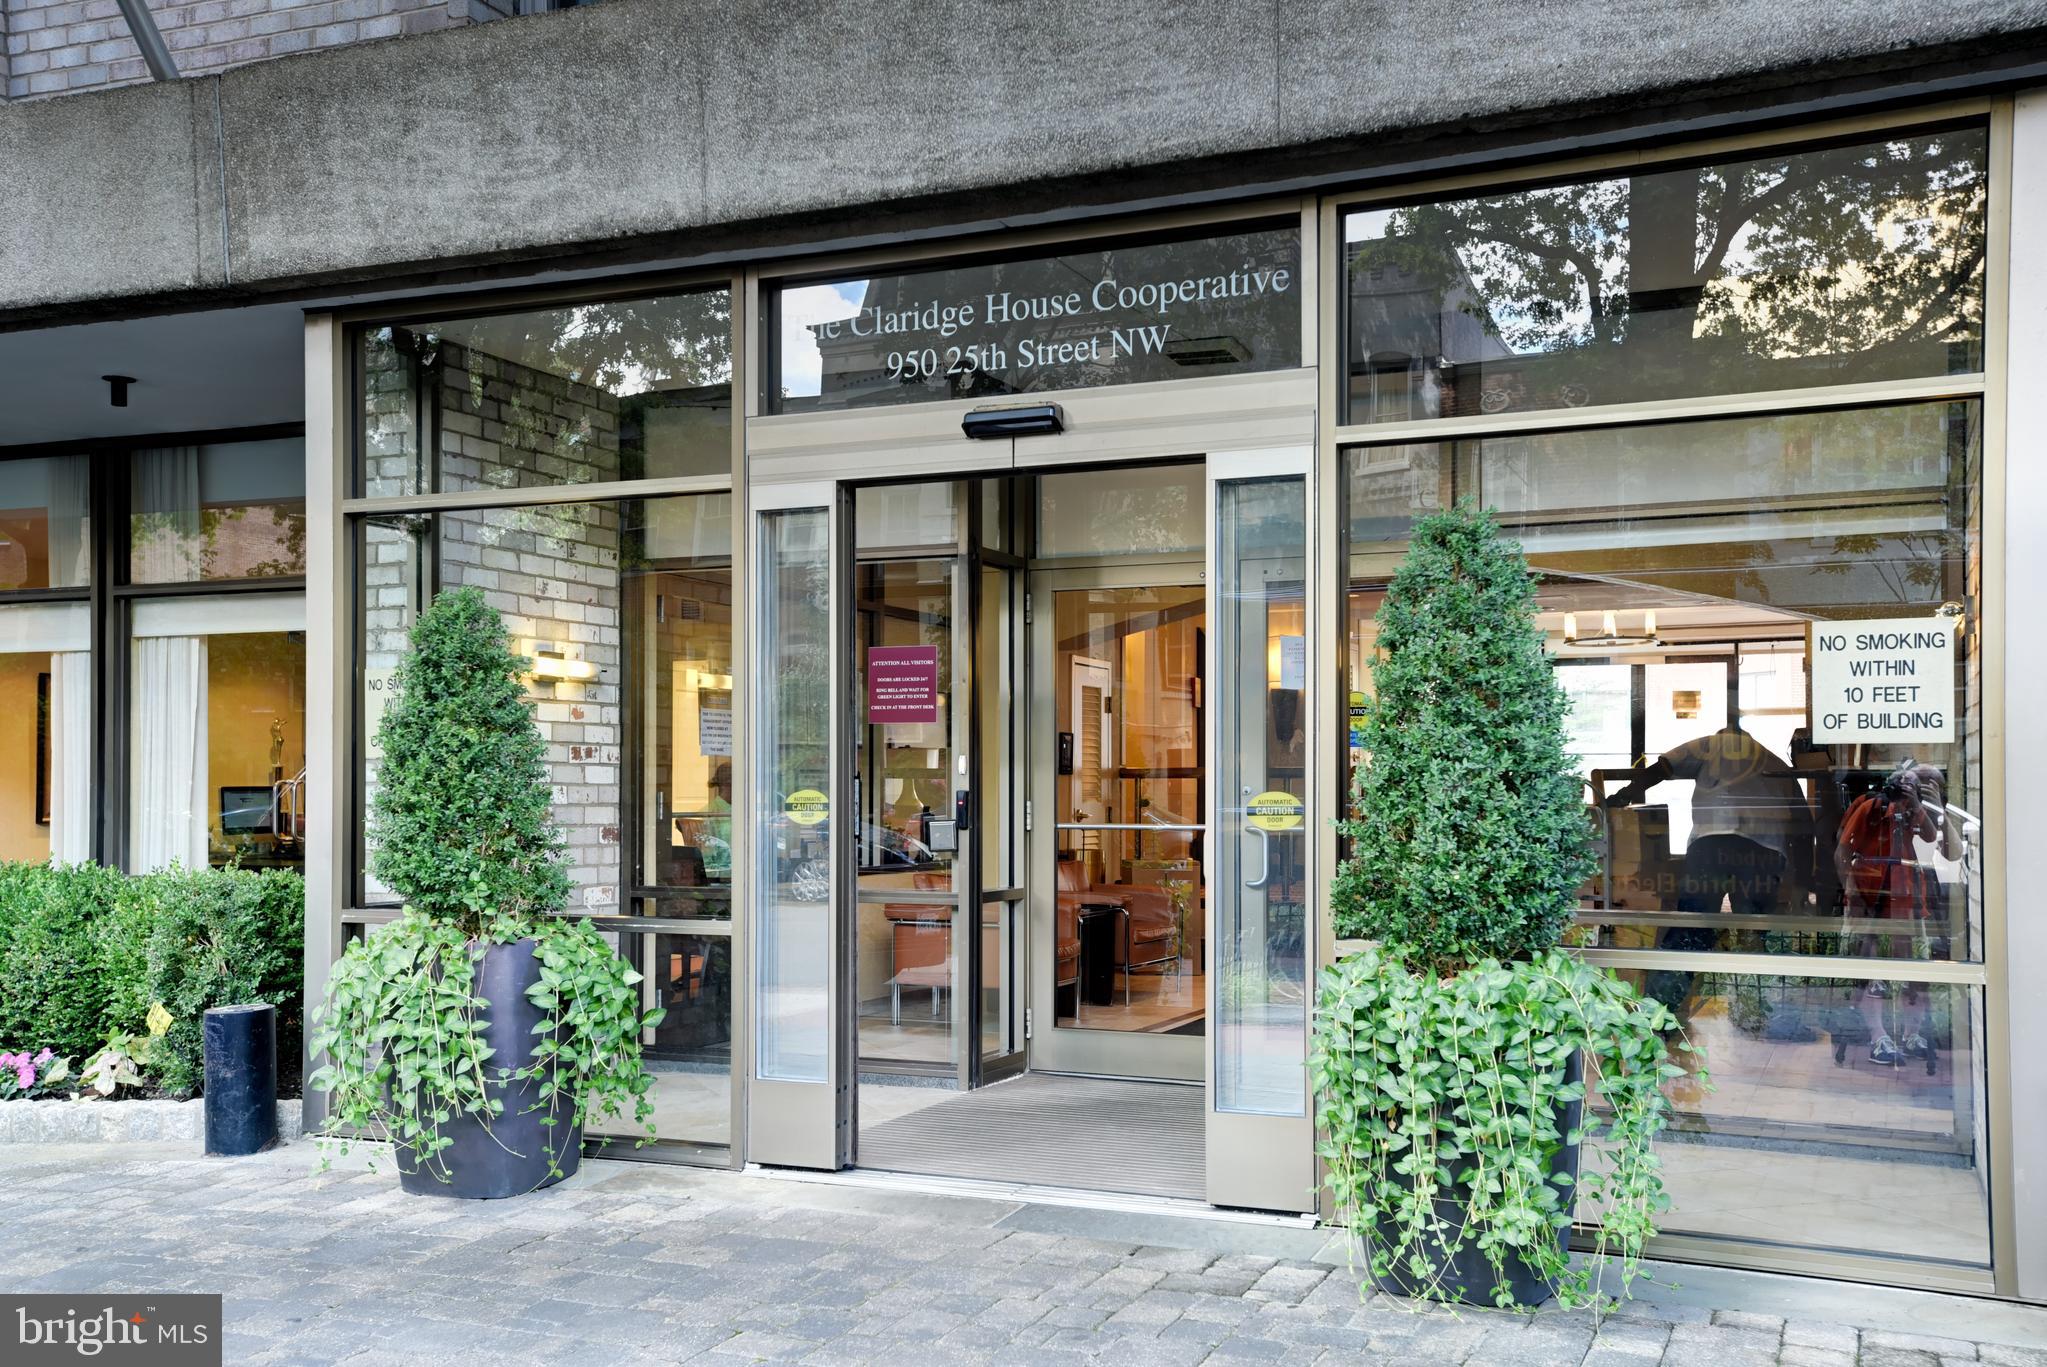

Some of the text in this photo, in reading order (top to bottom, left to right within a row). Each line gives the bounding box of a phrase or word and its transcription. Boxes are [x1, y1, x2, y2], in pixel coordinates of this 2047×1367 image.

[850, 299, 974, 337] Claridge
[985, 291, 1082, 325] House
[1092, 263, 1291, 314] Cooperative
[887, 324, 1173, 380] 950 25th Street NW
[1819, 632, 1946, 652] NO SMOKING
[1849, 660, 1915, 677] WITHIN
[368, 679, 383, 691] NO
[1844, 686, 1921, 703] 10 FEET
[1823, 712, 1943, 730] OF BUILDING
[792, 803, 824, 811] CAUTION
[1255, 806, 1295, 816] CAUTION
